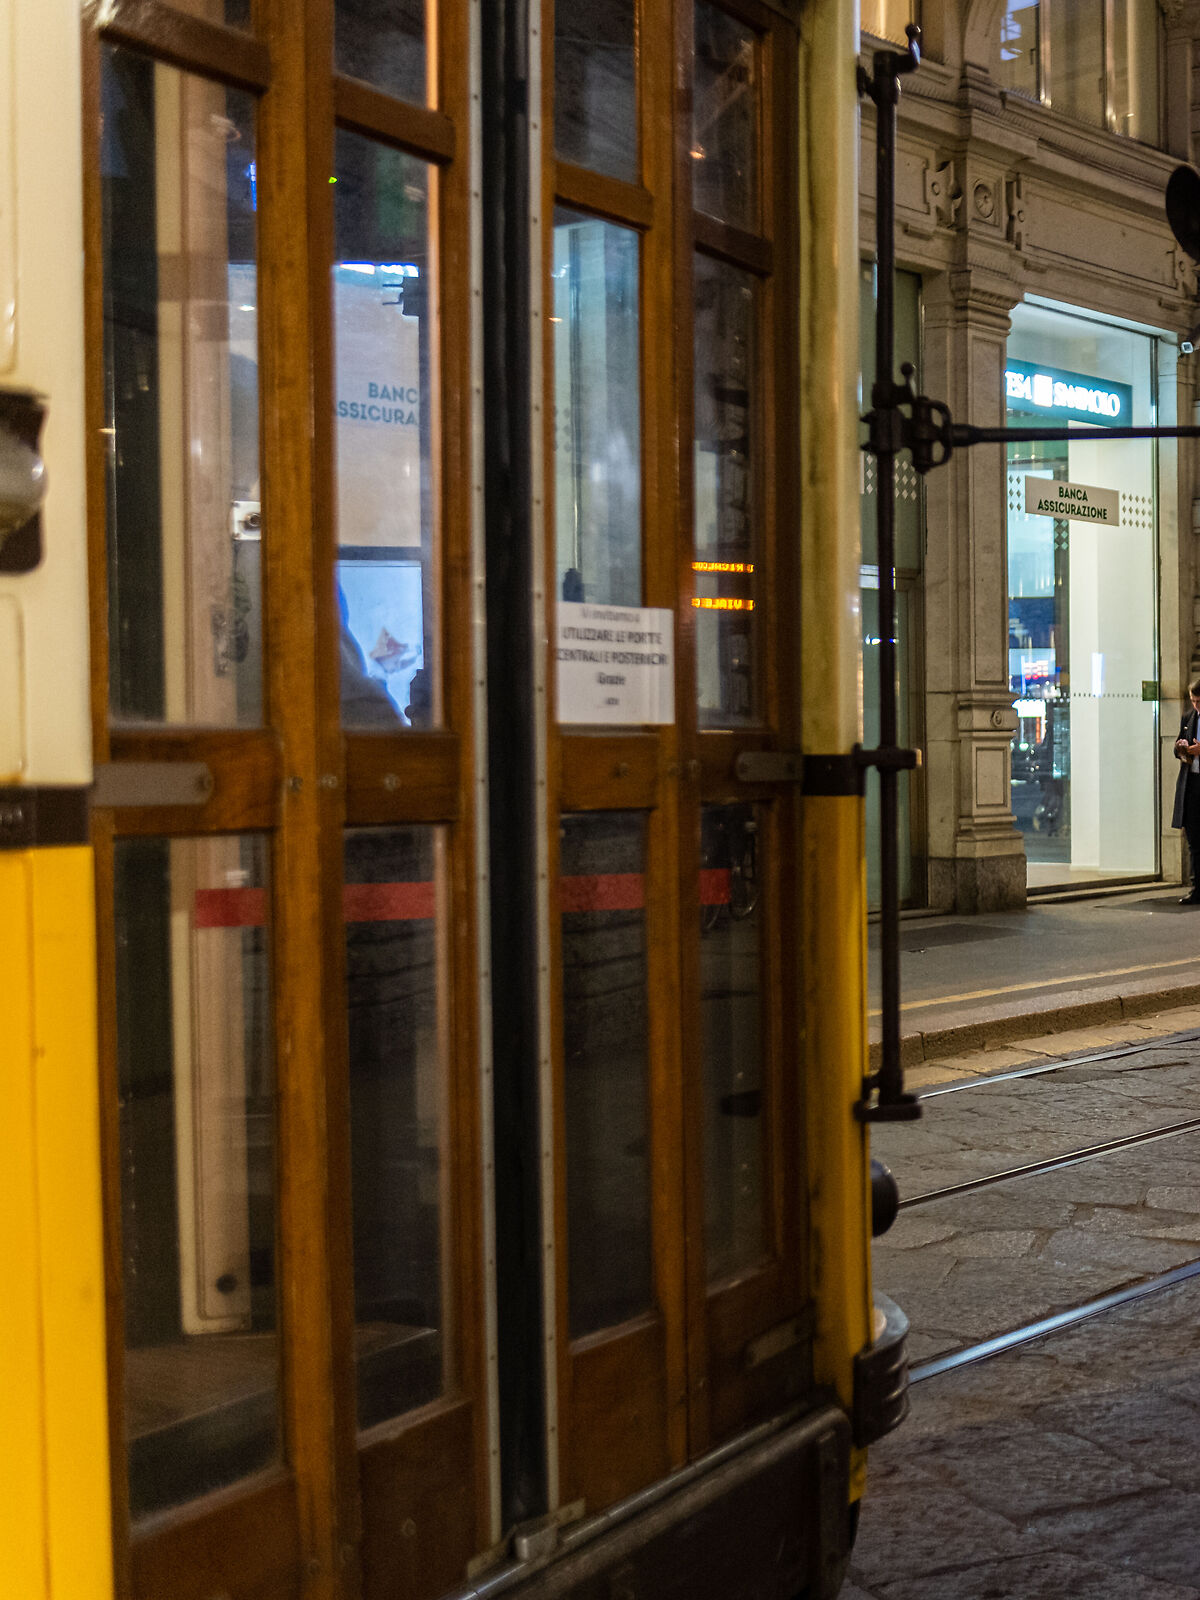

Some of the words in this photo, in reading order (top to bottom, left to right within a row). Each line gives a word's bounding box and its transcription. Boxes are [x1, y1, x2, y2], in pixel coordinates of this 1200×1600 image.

[368, 382, 418, 404] BANC
[1058, 487, 1088, 501] BANCA
[1038, 499, 1107, 520] ASSICURAZIONE
[562, 626, 612, 642] UTILIZZARE
[628, 631, 662, 644] PORTE
